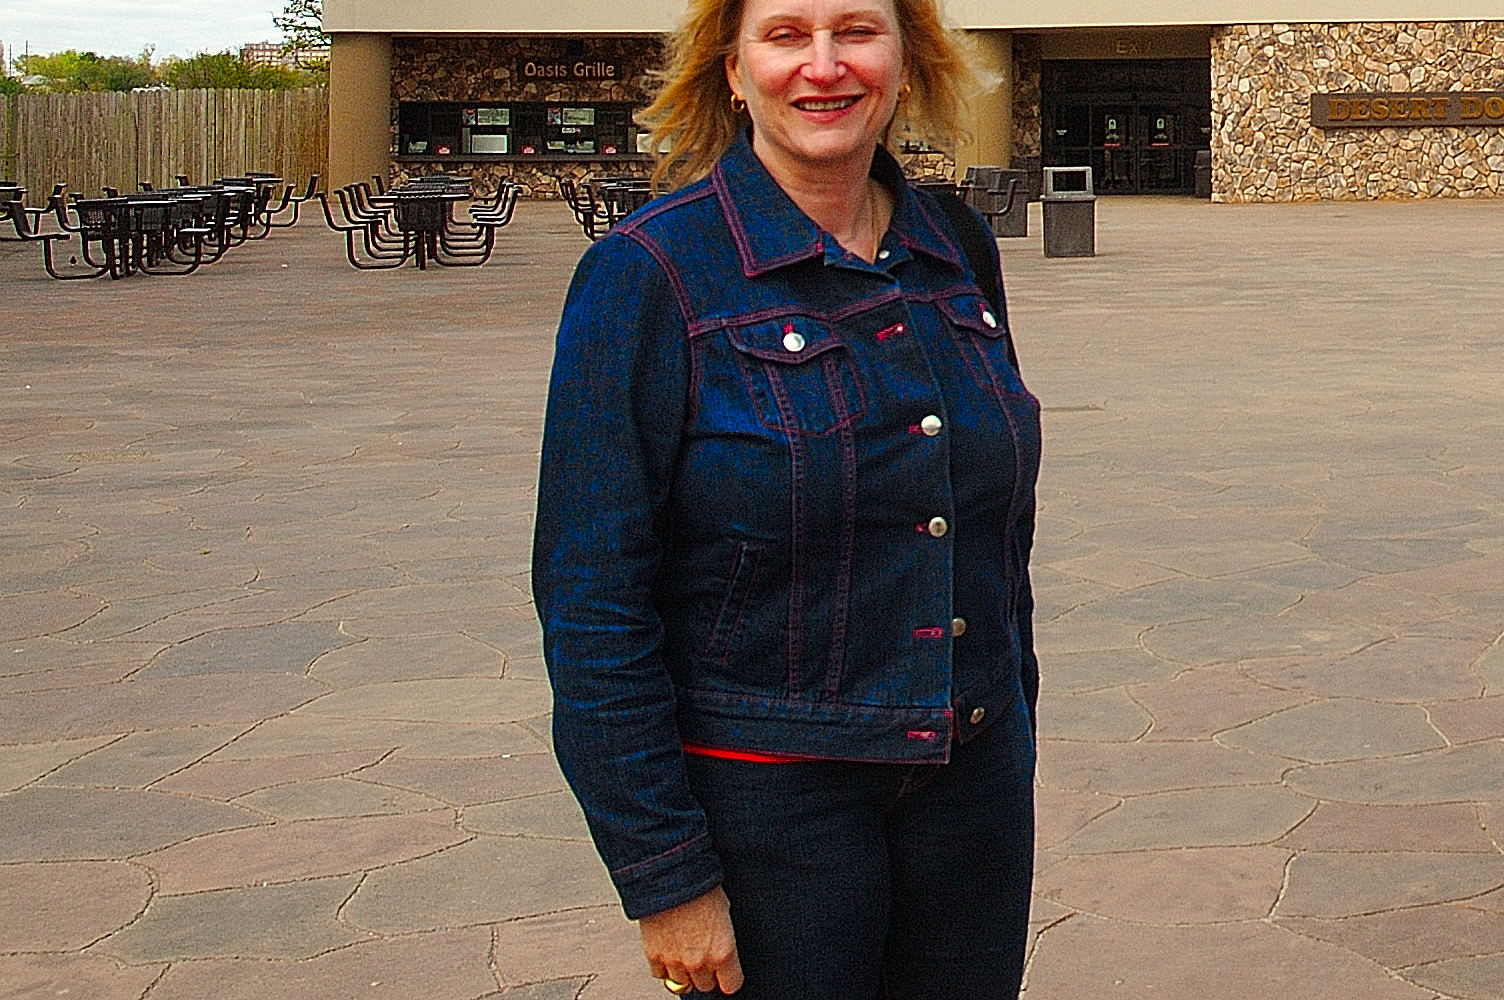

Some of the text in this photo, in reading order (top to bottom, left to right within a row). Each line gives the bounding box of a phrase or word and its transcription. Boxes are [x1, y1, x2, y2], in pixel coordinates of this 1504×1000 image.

[1115, 40, 1152, 55] Ex
[524, 61, 615, 77] Oasis Grille
[1327, 97, 1450, 121] DESERT
